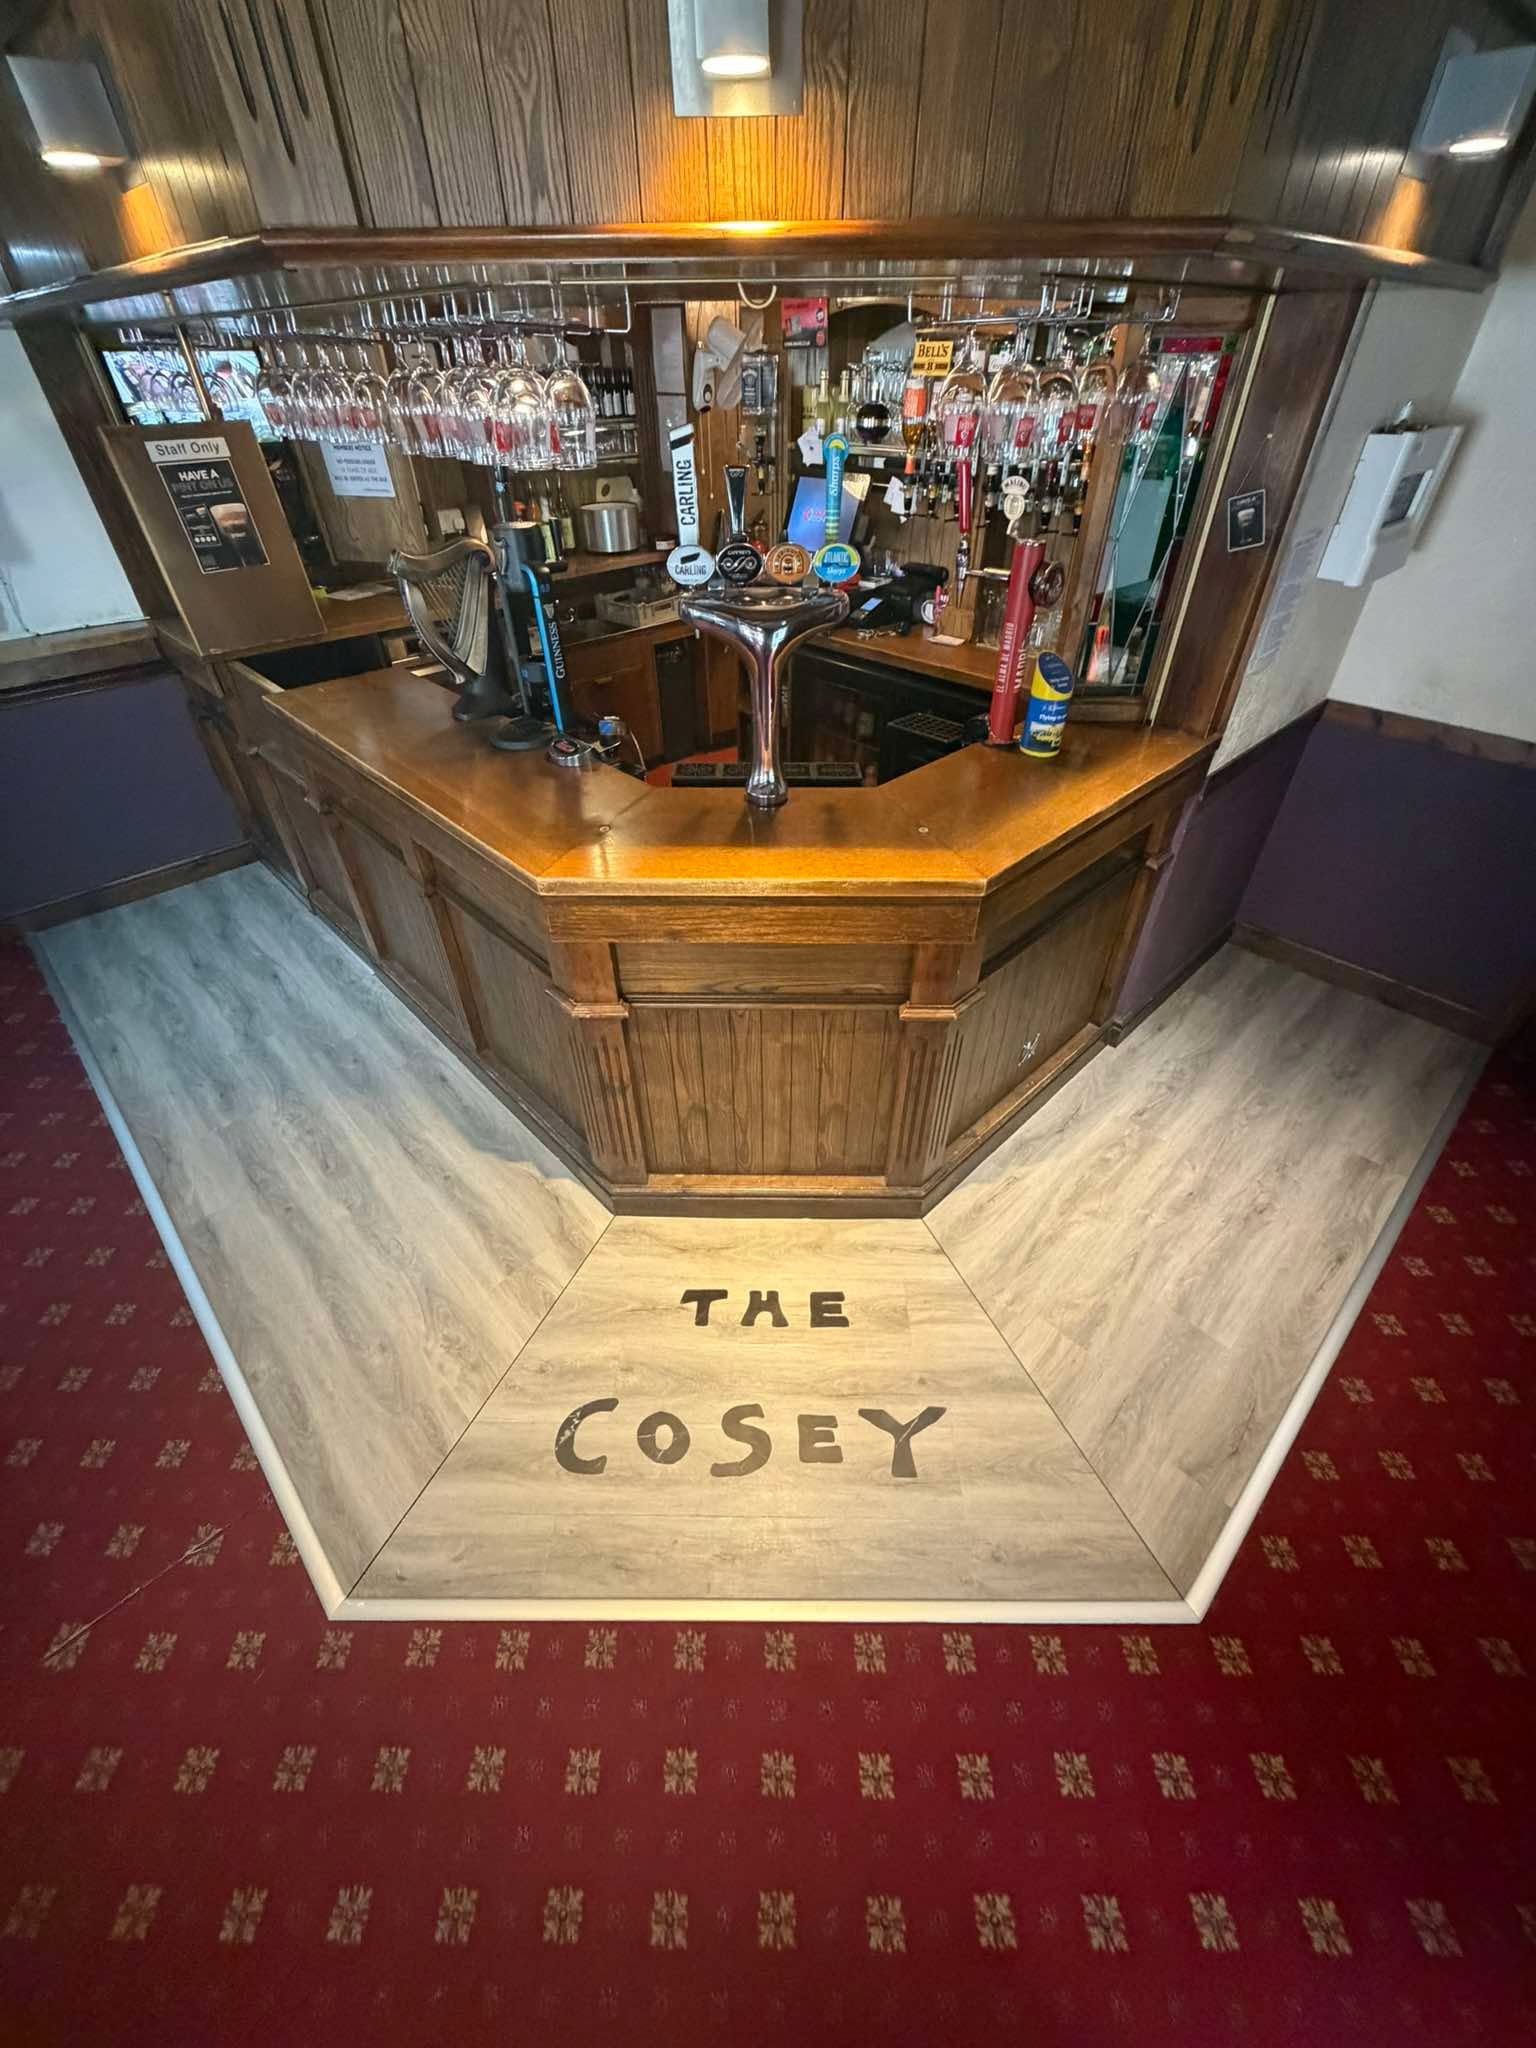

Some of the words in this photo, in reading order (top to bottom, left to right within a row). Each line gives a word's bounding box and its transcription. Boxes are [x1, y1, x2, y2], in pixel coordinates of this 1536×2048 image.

[918, 343, 950, 358] BELL'S
[154, 441, 187, 457] Staff
[190, 440, 220, 455] Only
[178, 468, 210, 482] HAVE
[210, 468, 220, 479] A
[677, 459, 698, 526] CARLING
[674, 564, 707, 576] CARLING
[1003, 622, 1015, 651] MADRID
[548, 621, 564, 679] GUINNESS
[1001, 653, 1010, 662] DE
[998, 664, 1008, 683] ALMA
[996, 684, 1005, 693] EL
[680, 1289, 850, 1328] THE
[554, 1396, 947, 1479] COSEY
